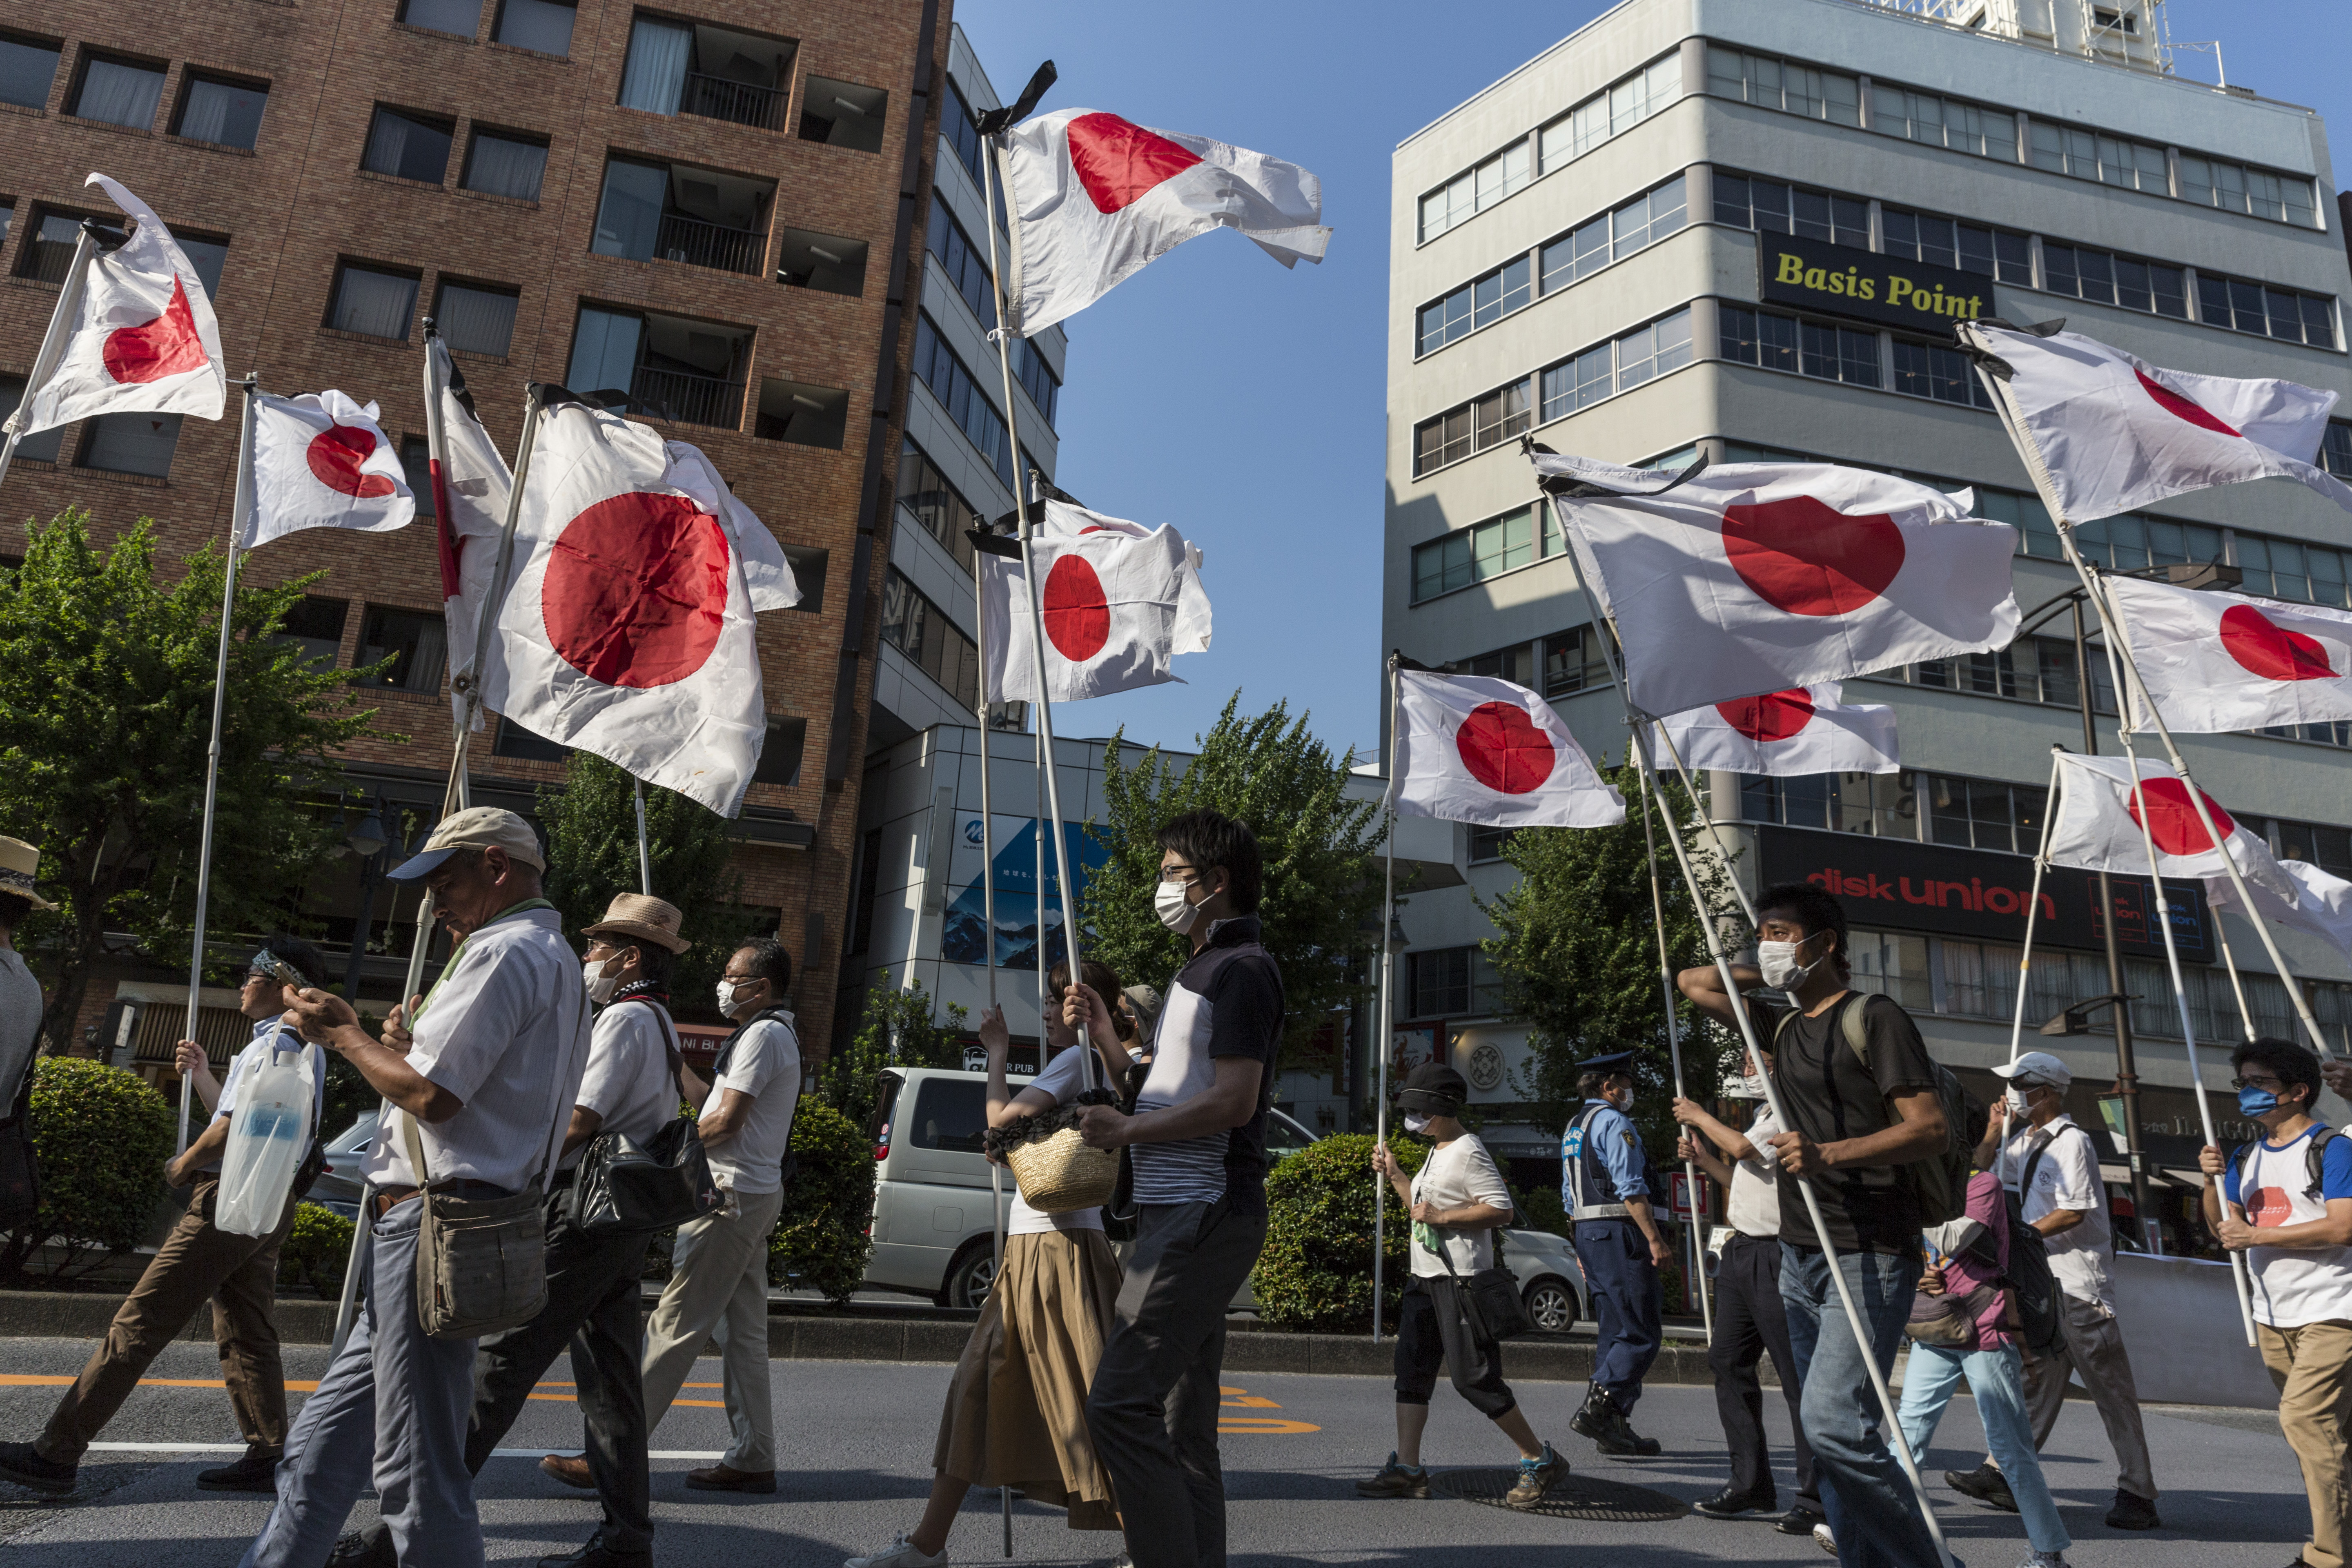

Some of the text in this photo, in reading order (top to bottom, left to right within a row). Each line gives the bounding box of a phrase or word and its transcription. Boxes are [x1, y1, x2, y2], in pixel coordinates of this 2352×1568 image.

[1775, 252, 1982, 319] Basis Point
[1003, 869, 1057, 881] 地球を、しも
[1806, 868, 2056, 920] disk union
[2094, 906, 2141, 920] uion
[2152, 913, 2196, 927] uion
[702, 1039, 725, 1051] BL
[1015, 1063, 1034, 1073] PUB
[256, 1114, 293, 1125] WAER
